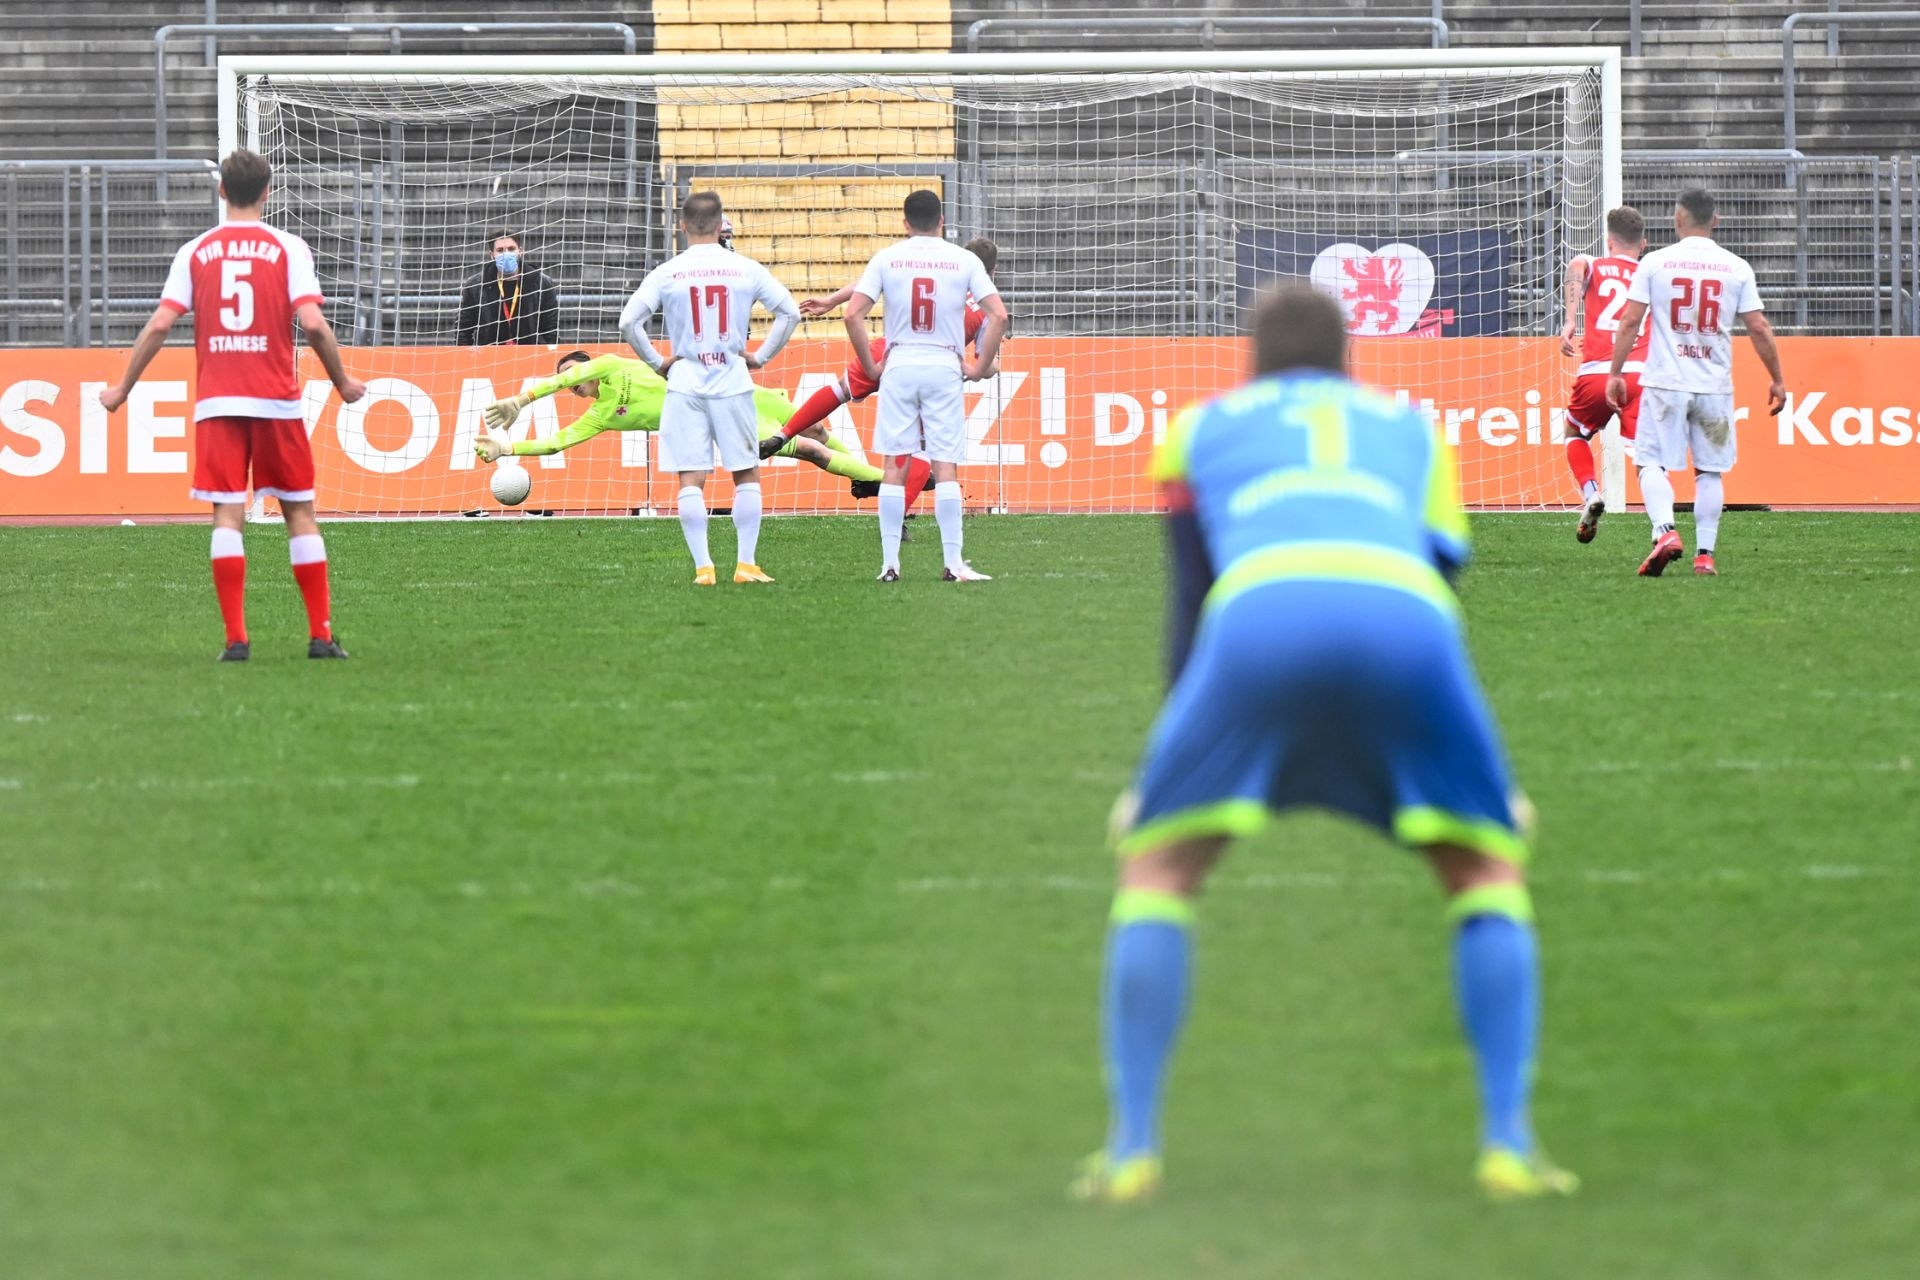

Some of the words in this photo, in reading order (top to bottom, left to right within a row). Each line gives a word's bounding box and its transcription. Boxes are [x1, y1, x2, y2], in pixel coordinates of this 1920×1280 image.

[227, 239, 282, 265] AALEN
[890, 260, 904, 269] KSV
[905, 260, 933, 269] HESSEN
[934, 261, 960, 271] KASSEL
[1663, 261, 1677, 269] KSV
[1679, 261, 1706, 271] HESSEN
[1707, 263, 1732, 273] KASSEL
[672, 271, 687, 280] KSV
[688, 269, 716, 278] HESSEN
[717, 269, 744, 278] KASSEL
[220, 260, 255, 332] 5
[689, 285, 730, 343] 17
[911, 277, 937, 334] 6
[1670, 277, 1724, 335] 26
[209, 335, 268, 352] STANESE
[697, 351, 727, 366] MEHA
[1676, 344, 1712, 359] SAGLIK
[0, 379, 188, 477] SIE
[1094, 390, 1168, 446] Di
[1777, 391, 1920, 447] Kas
[1278, 402, 1352, 473] 1
